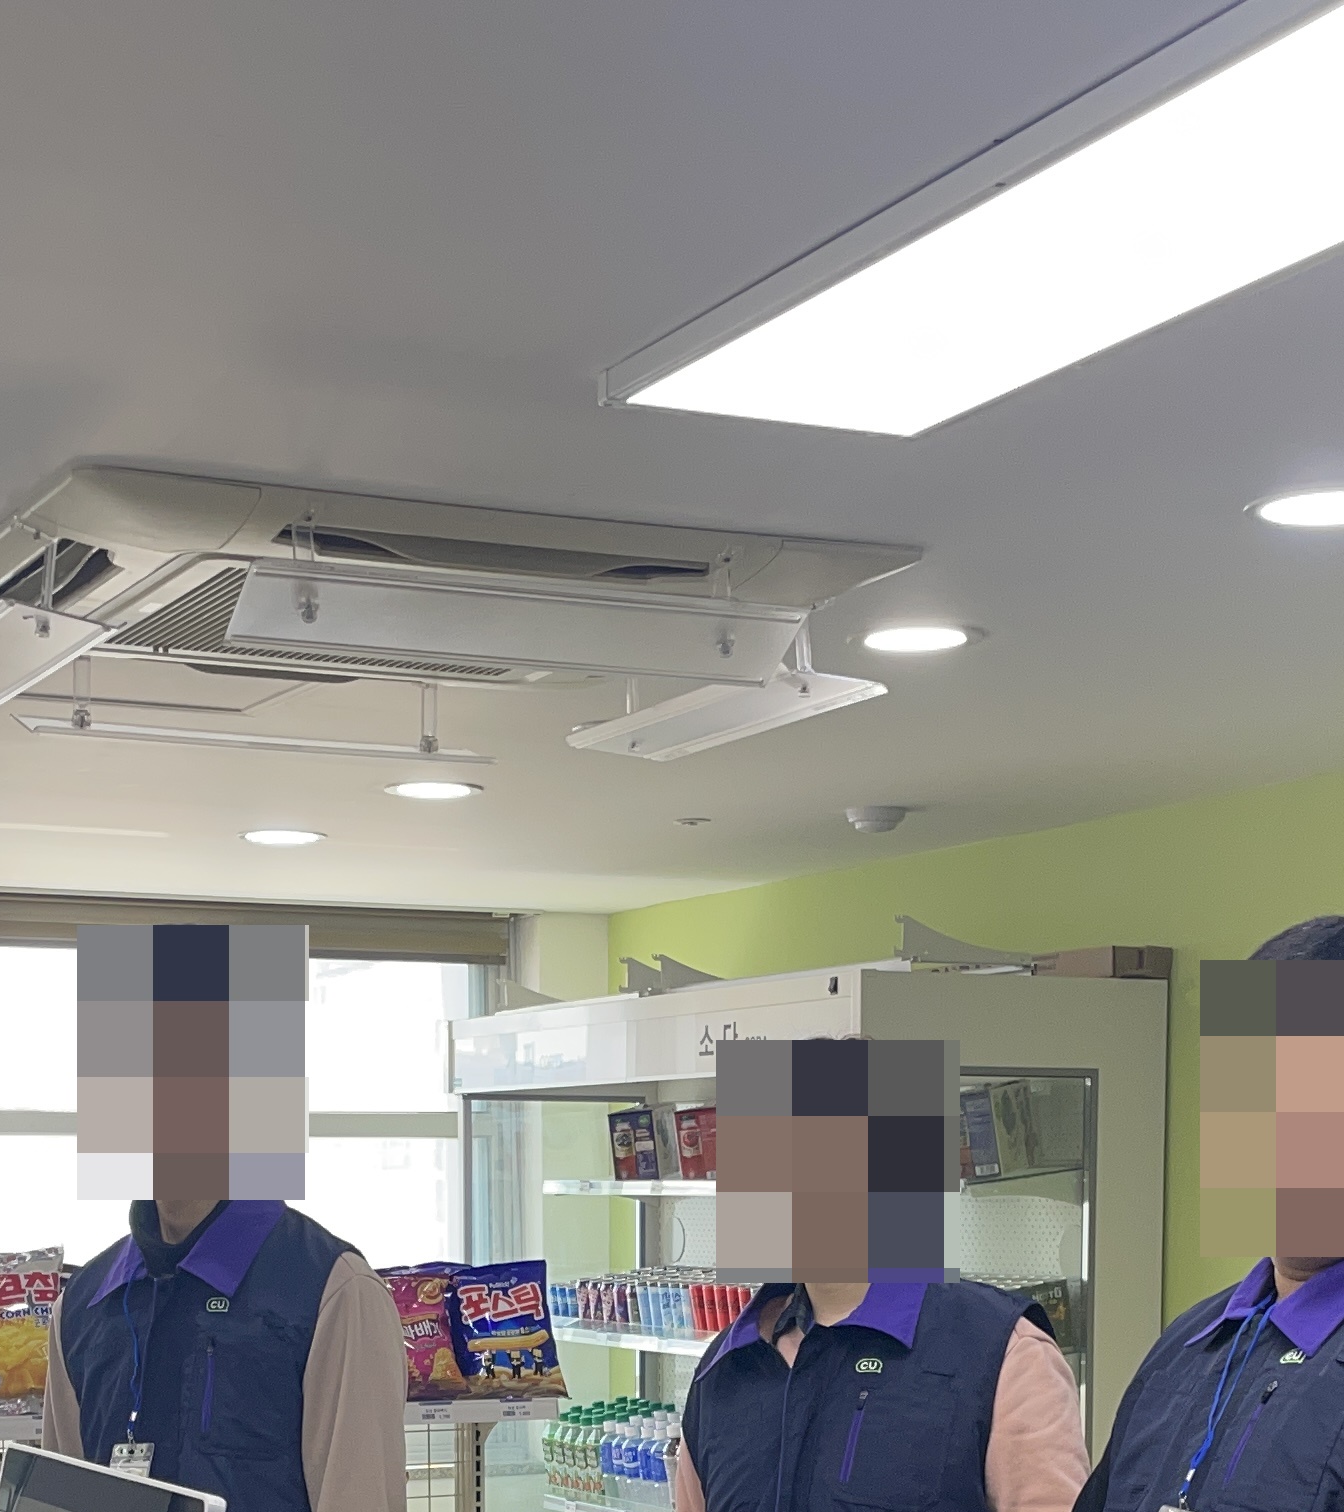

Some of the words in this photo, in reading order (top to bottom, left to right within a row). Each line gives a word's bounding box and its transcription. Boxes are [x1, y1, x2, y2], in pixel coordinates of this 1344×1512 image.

[209, 1299, 226, 1310] CU
[457, 1281, 545, 1325] 포스틱
[0, 1306, 31, 1320] CORN
[34, 1306, 52, 1316] CHI
[1284, 1350, 1304, 1361] CU
[859, 1360, 878, 1370] CU
